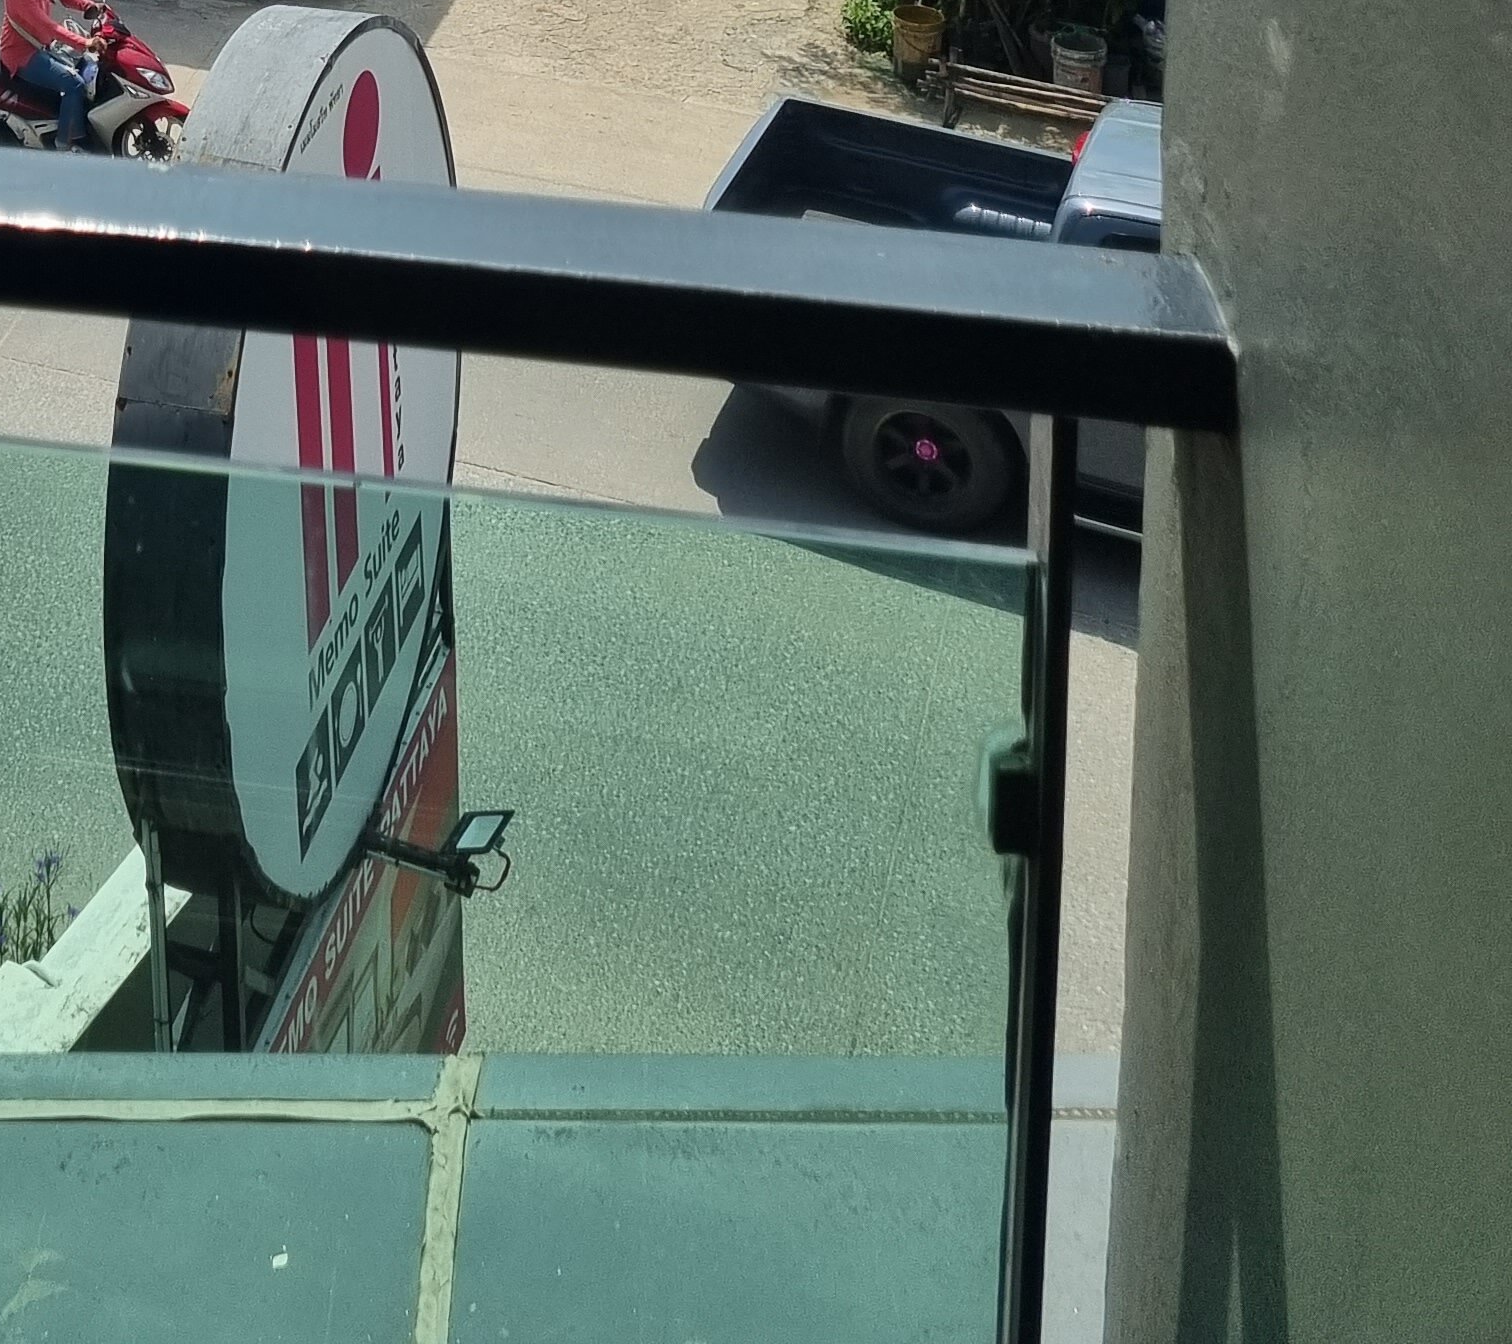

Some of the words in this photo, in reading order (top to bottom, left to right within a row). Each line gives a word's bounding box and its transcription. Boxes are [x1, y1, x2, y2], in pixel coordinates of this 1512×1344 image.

[308, 592, 360, 712] Memo
[363, 509, 401, 598] Suite
[323, 858, 376, 980] SUITE
